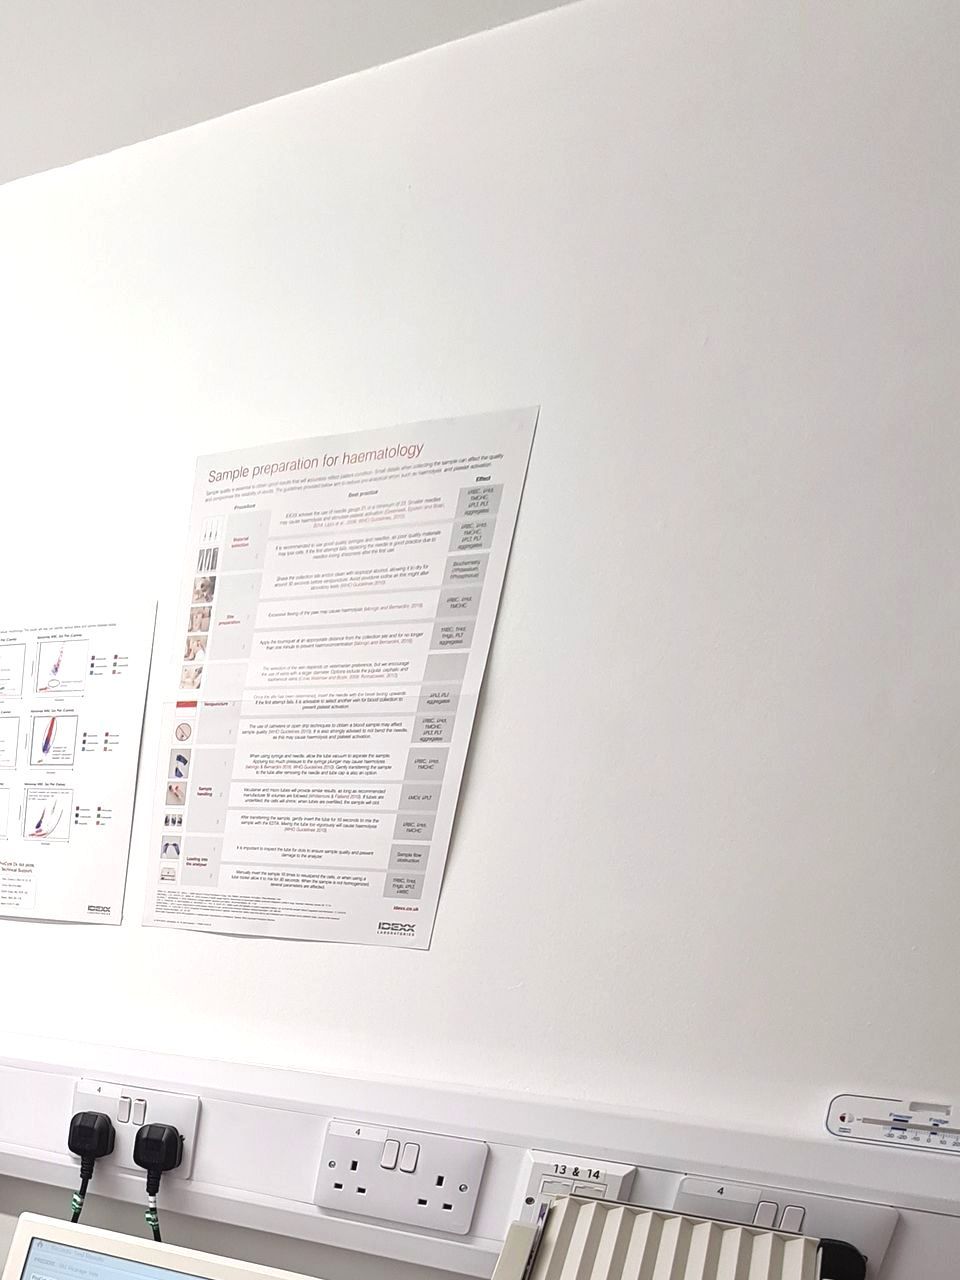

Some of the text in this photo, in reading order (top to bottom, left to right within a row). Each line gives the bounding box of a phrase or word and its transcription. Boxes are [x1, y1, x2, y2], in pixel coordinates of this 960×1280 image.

[208, 468, 249, 484] Sample
[251, 457, 319, 480] preparation
[322, 453, 339, 468] for
[342, 442, 424, 466] haematology
[378, 922, 416, 932] IDEXX
[355, 1128, 361, 1136] 4
[553, 1164, 601, 1180] 13 & 14
[717, 1186, 724, 1195] 4
